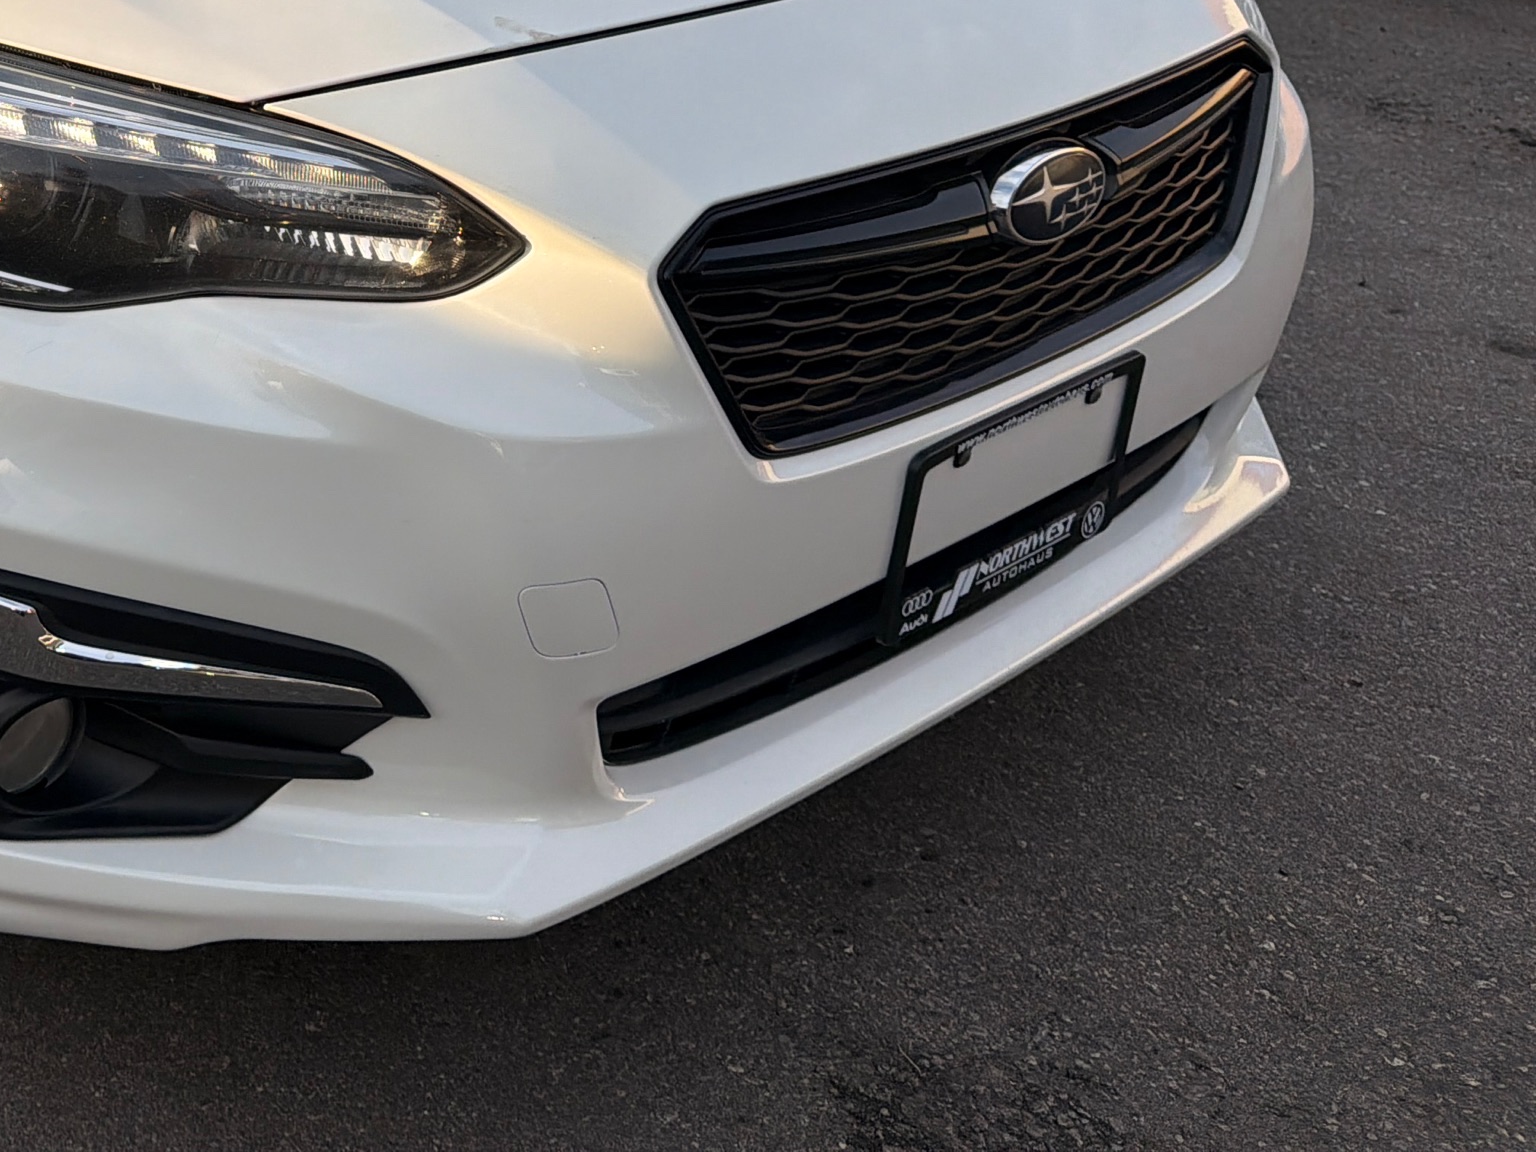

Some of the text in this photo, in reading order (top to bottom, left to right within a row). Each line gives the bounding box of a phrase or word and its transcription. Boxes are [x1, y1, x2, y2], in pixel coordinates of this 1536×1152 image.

[976, 512, 1077, 580] NORTHWEST
[981, 546, 1055, 593] AUTOHAUS
[898, 613, 929, 636] Audi
